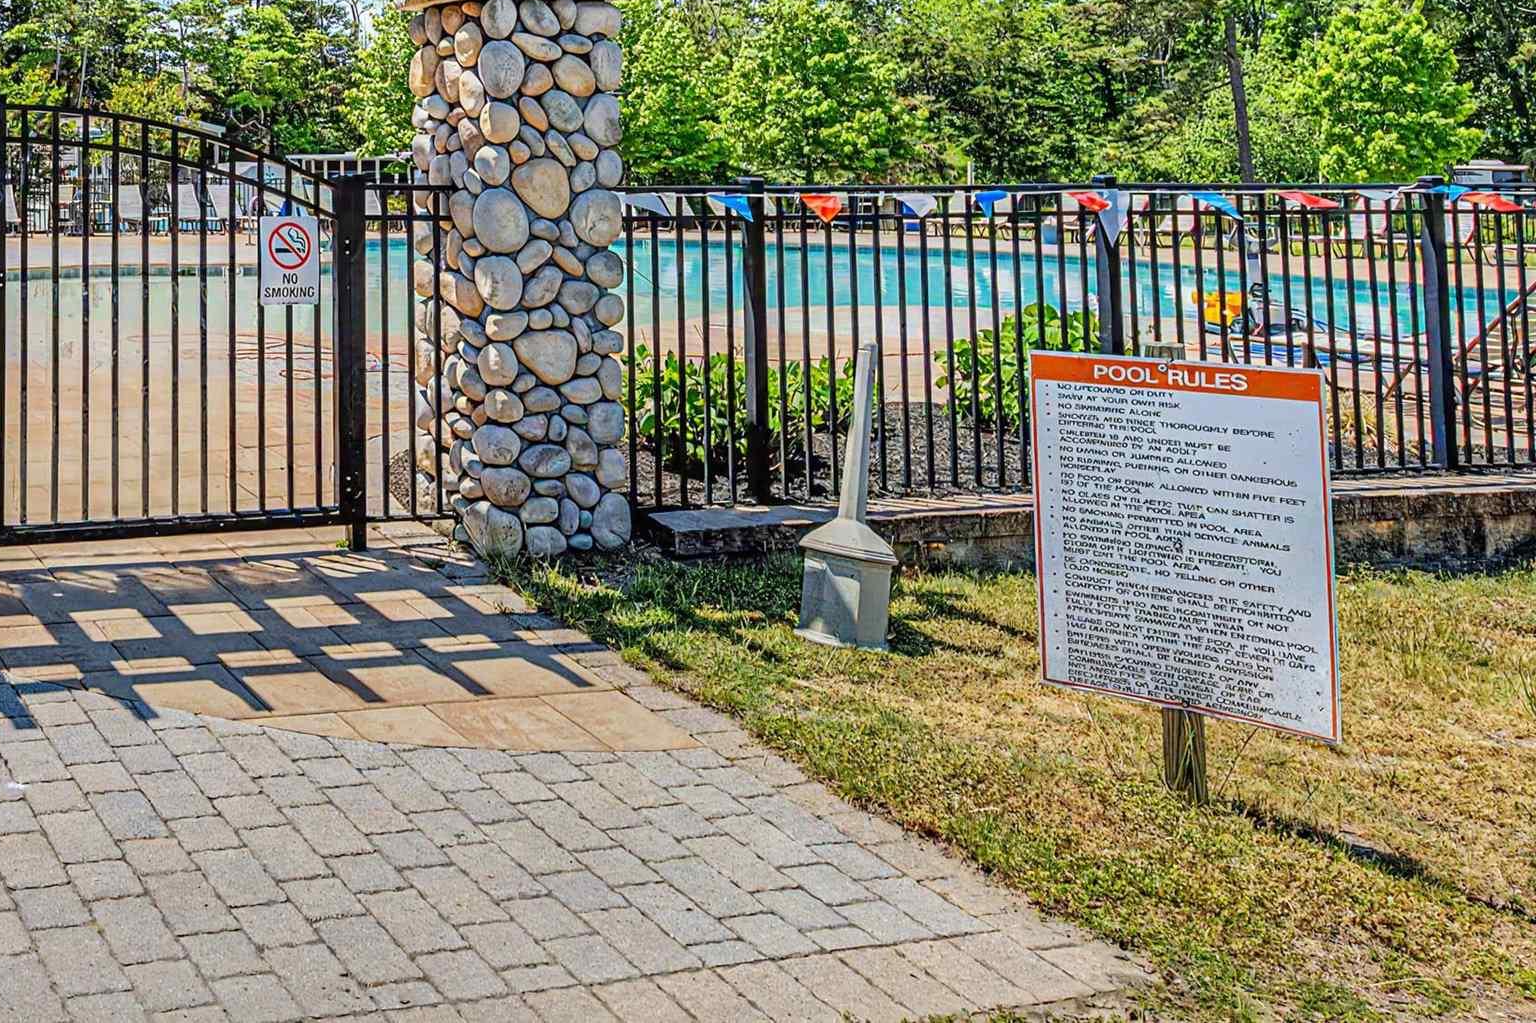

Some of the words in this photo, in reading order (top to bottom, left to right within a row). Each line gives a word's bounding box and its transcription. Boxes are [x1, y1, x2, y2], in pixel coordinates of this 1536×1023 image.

[282, 273, 298, 284] NO
[264, 286, 315, 298] SMOKING
[1093, 364, 1157, 384] POOL
[1167, 368, 1248, 391] RULES
[1185, 441, 1213, 449] MUST
[1206, 506, 1228, 514] CAN
[1200, 523, 1229, 533] POOL
[1233, 527, 1262, 537] AREA
[1242, 539, 1290, 551] ANIMALS
[1259, 567, 1281, 576] YOU
[1287, 608, 1311, 617] AND
[1266, 623, 1289, 632] NOT
